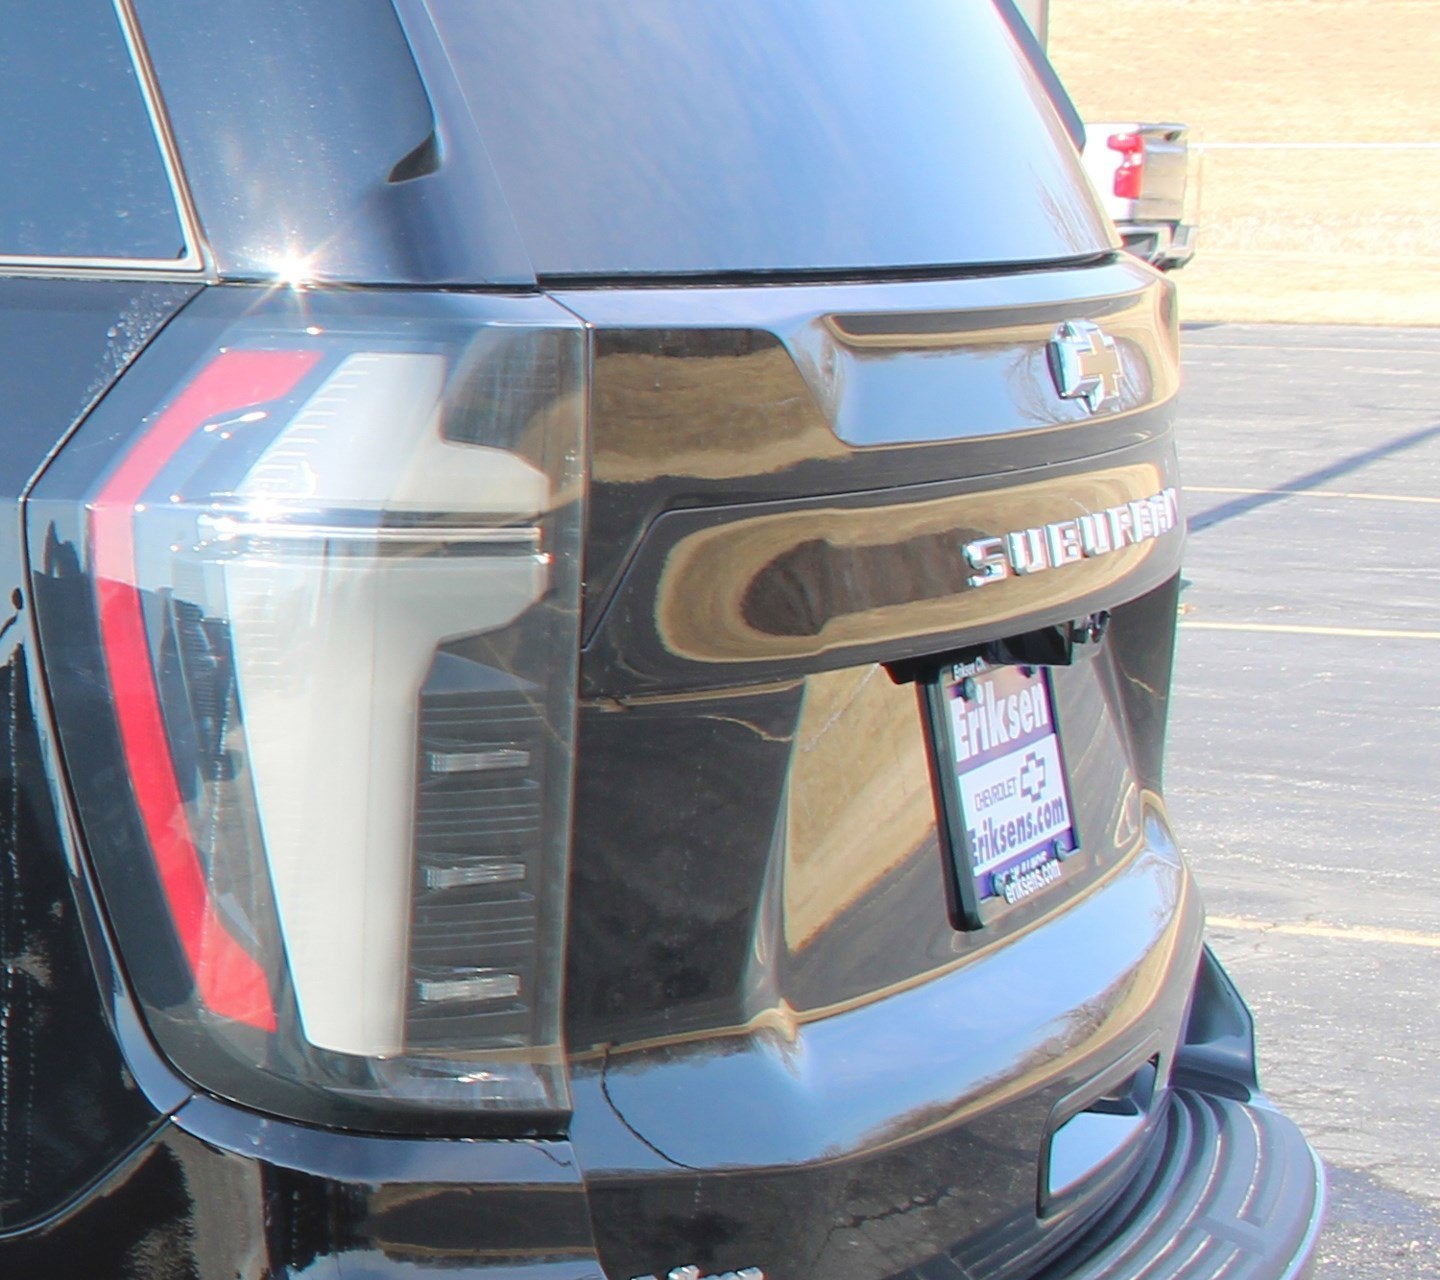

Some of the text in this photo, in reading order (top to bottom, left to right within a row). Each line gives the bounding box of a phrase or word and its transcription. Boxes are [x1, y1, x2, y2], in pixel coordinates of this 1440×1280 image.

[962, 488, 1178, 588] SUBURBAN
[950, 680, 1049, 764] Eriksen
[975, 776, 1018, 812] CHEVROLET
[965, 795, 1066, 867] Eriksens.com
[1004, 858, 1062, 904] eriksens.com
